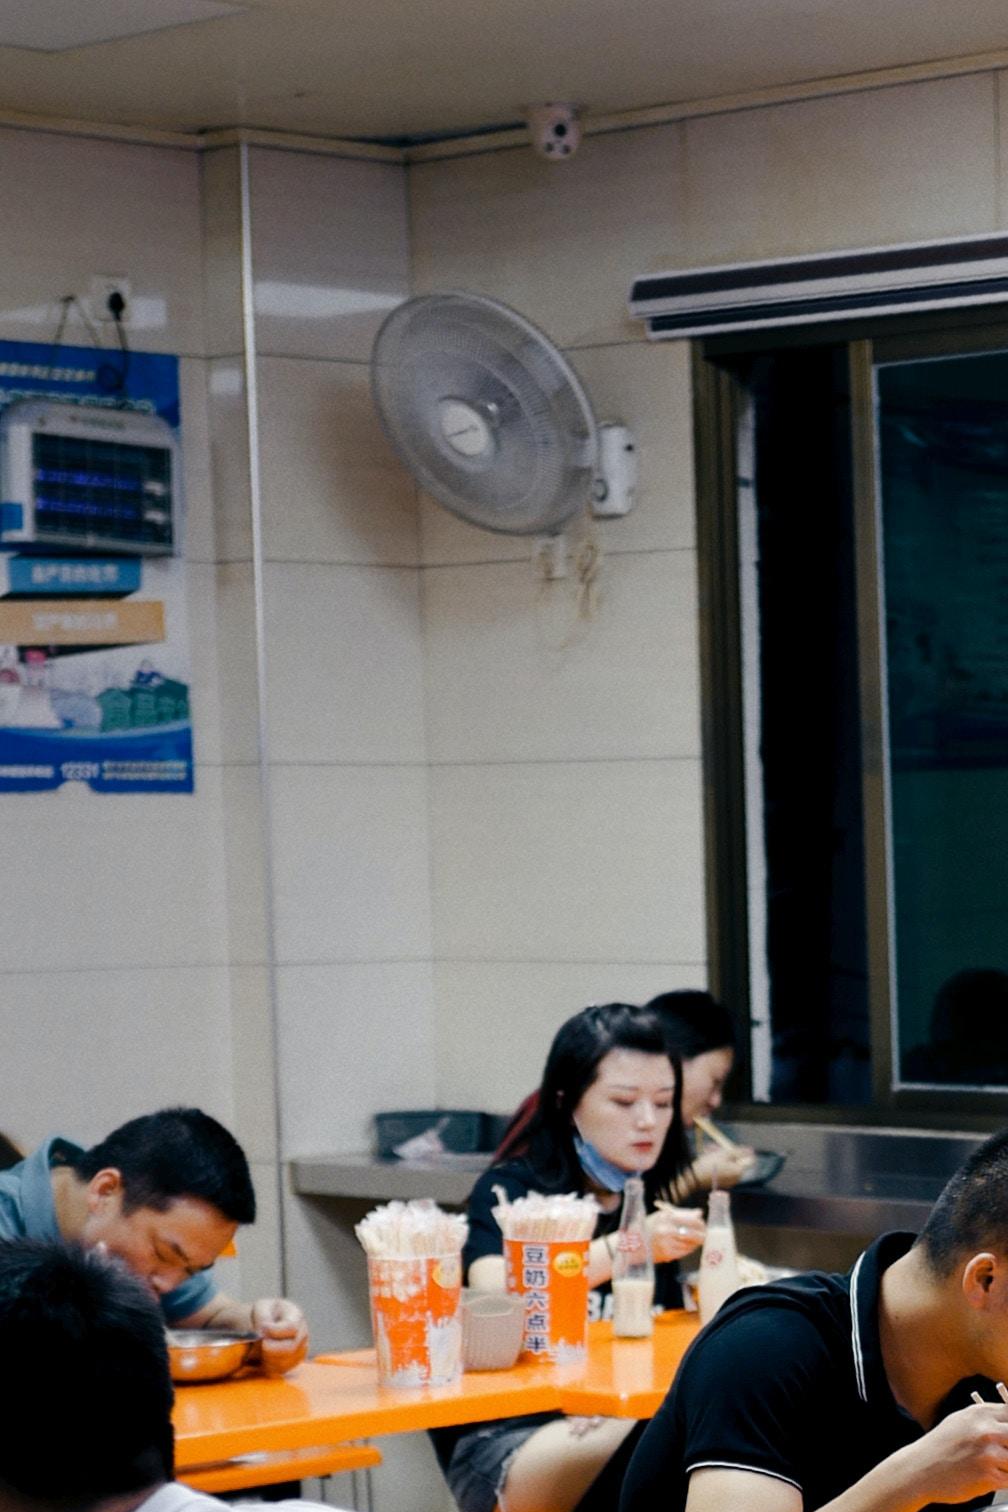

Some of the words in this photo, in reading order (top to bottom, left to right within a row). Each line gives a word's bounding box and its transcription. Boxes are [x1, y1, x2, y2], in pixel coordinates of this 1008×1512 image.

[524, 1247, 547, 1352] 豆奶六点半
